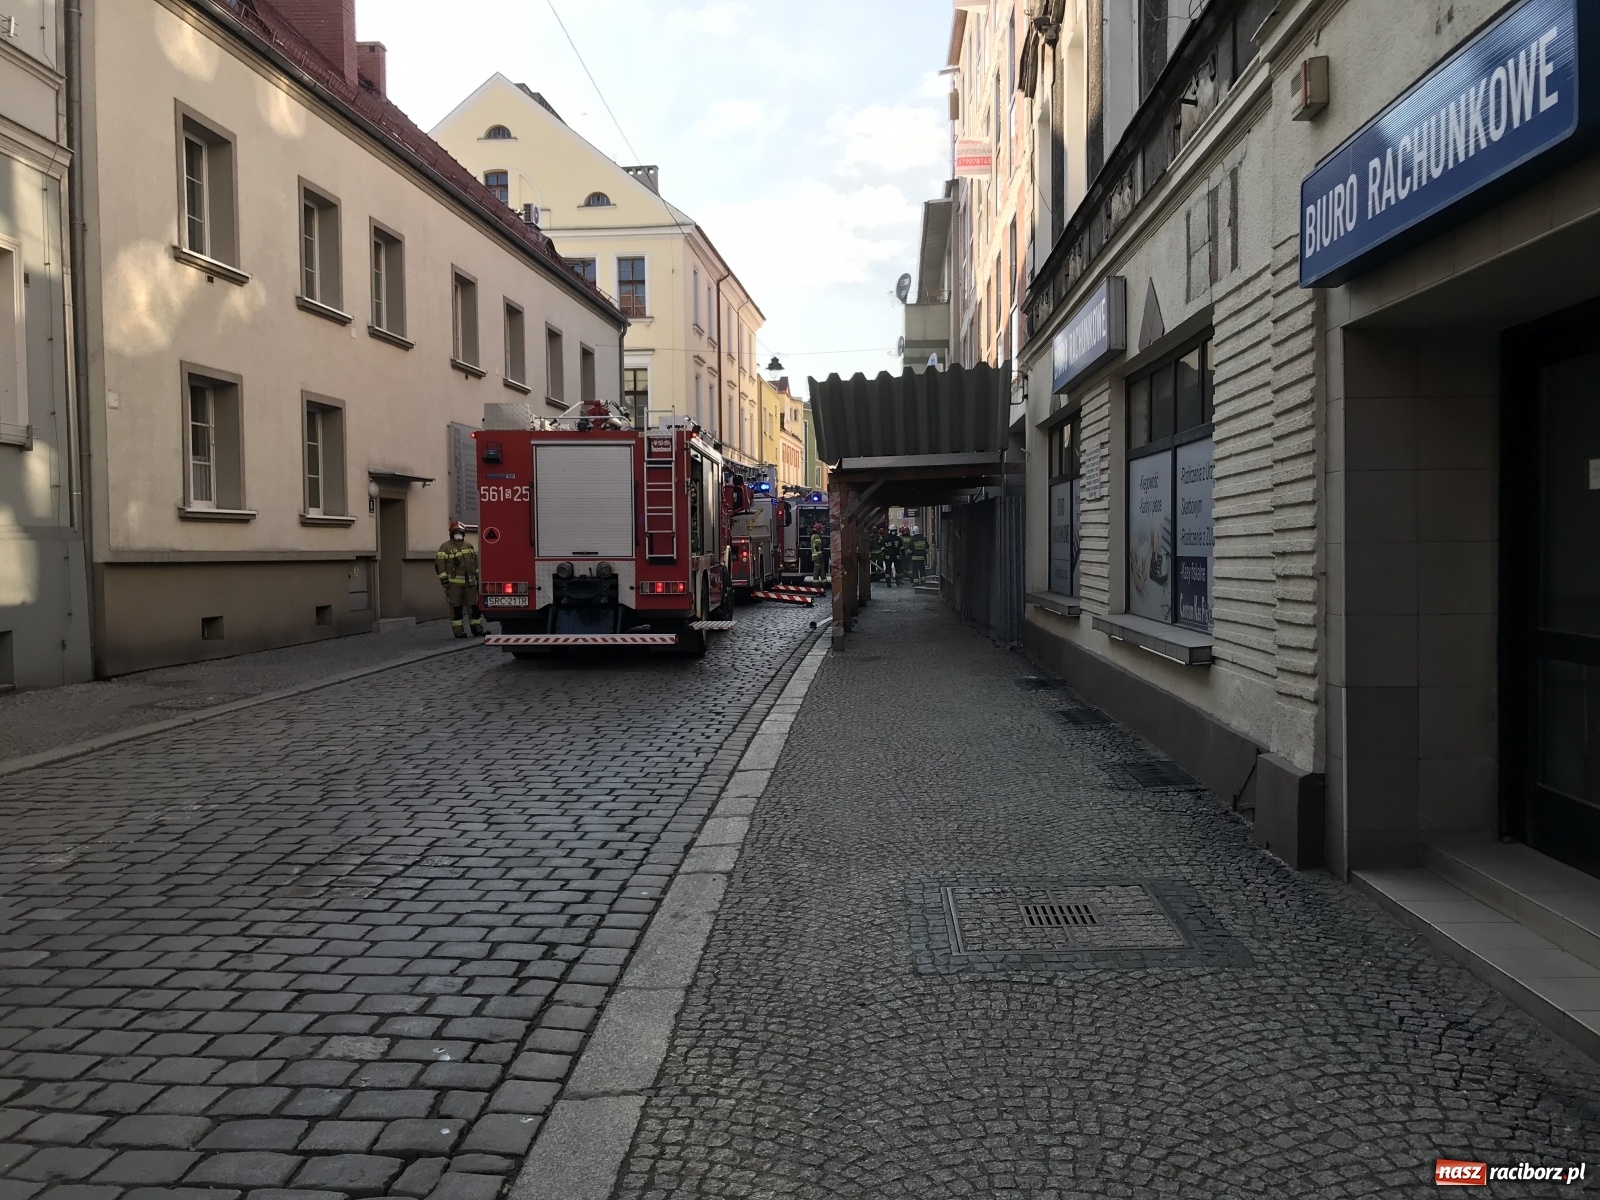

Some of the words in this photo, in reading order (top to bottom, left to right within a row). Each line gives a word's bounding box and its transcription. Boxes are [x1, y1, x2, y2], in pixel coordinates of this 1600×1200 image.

[1305, 173, 1357, 259] BIURO
[1367, 26, 1559, 219] RACHUNKOWE
[1069, 297, 1106, 367] RACHUNKOWE
[488, 597, 506, 605] SRC
